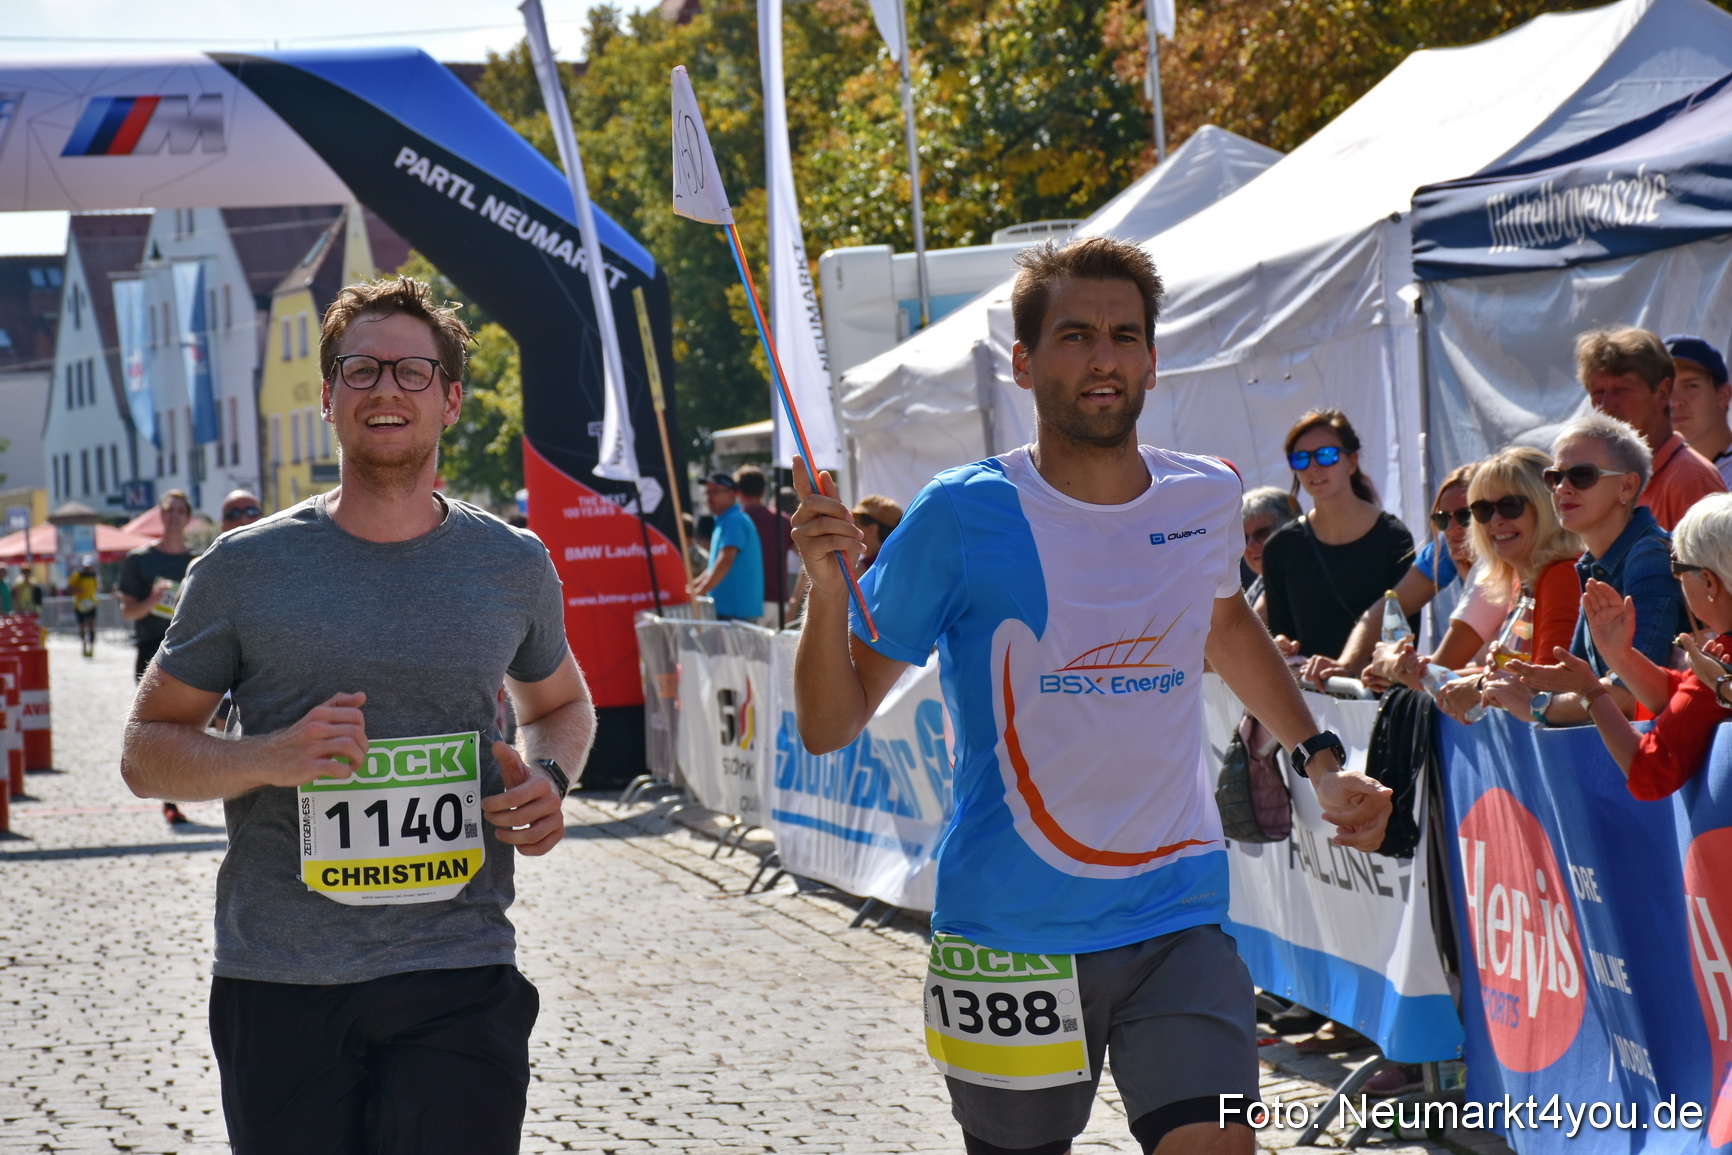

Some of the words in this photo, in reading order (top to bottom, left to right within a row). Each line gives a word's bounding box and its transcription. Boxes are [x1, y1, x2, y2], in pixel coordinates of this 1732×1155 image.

[394, 146, 476, 211] PARTL
[1486, 162, 1668, 255] Mittelbayerische
[565, 546, 603, 562] BMW
[1040, 674, 1106, 695] BSX
[1111, 668, 1185, 694] Energie
[324, 793, 463, 849] 1140
[321, 857, 469, 887] CHRISTIAN
[1458, 837, 1580, 1019] Hervis
[930, 984, 1061, 1037] 1388
[1481, 985, 1521, 1029] PORTS
